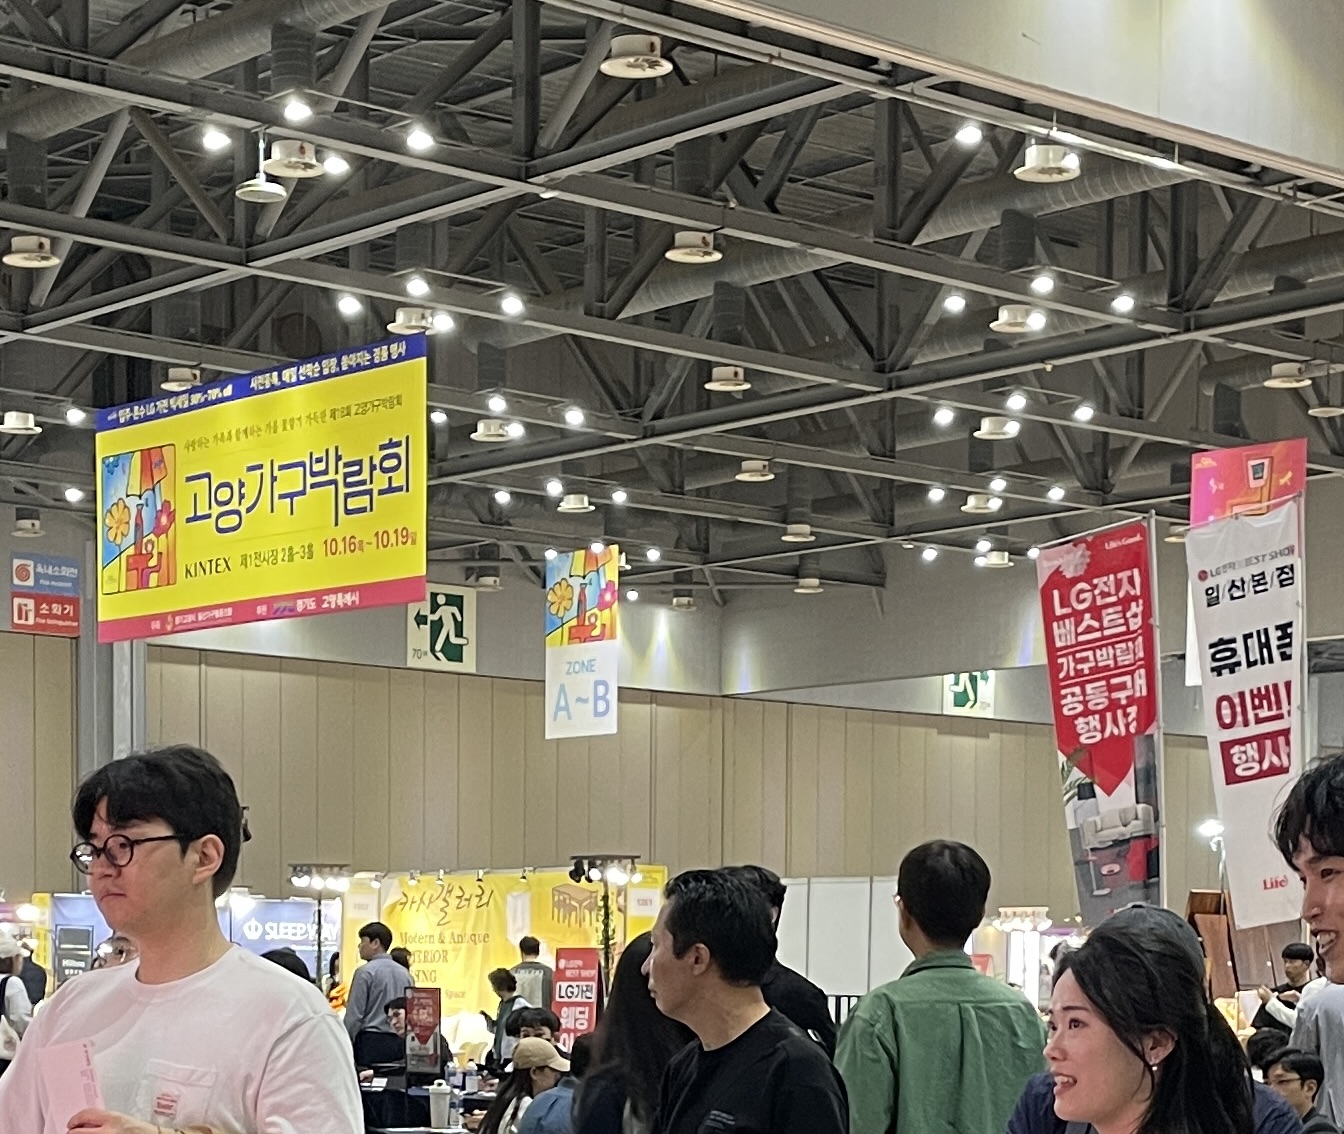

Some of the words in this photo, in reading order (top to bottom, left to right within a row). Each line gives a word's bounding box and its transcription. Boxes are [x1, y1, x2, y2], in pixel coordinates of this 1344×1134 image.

[183, 433, 411, 535] 고양가구박람회
[184, 555, 232, 580] KINTEX
[39, 602, 74, 617] 소화기
[565, 658, 596, 676] ZONE
[1215, 680, 1292, 730] 이벤
[558, 983, 594, 1000] LG가전
[560, 1006, 590, 1031] 웨딩
